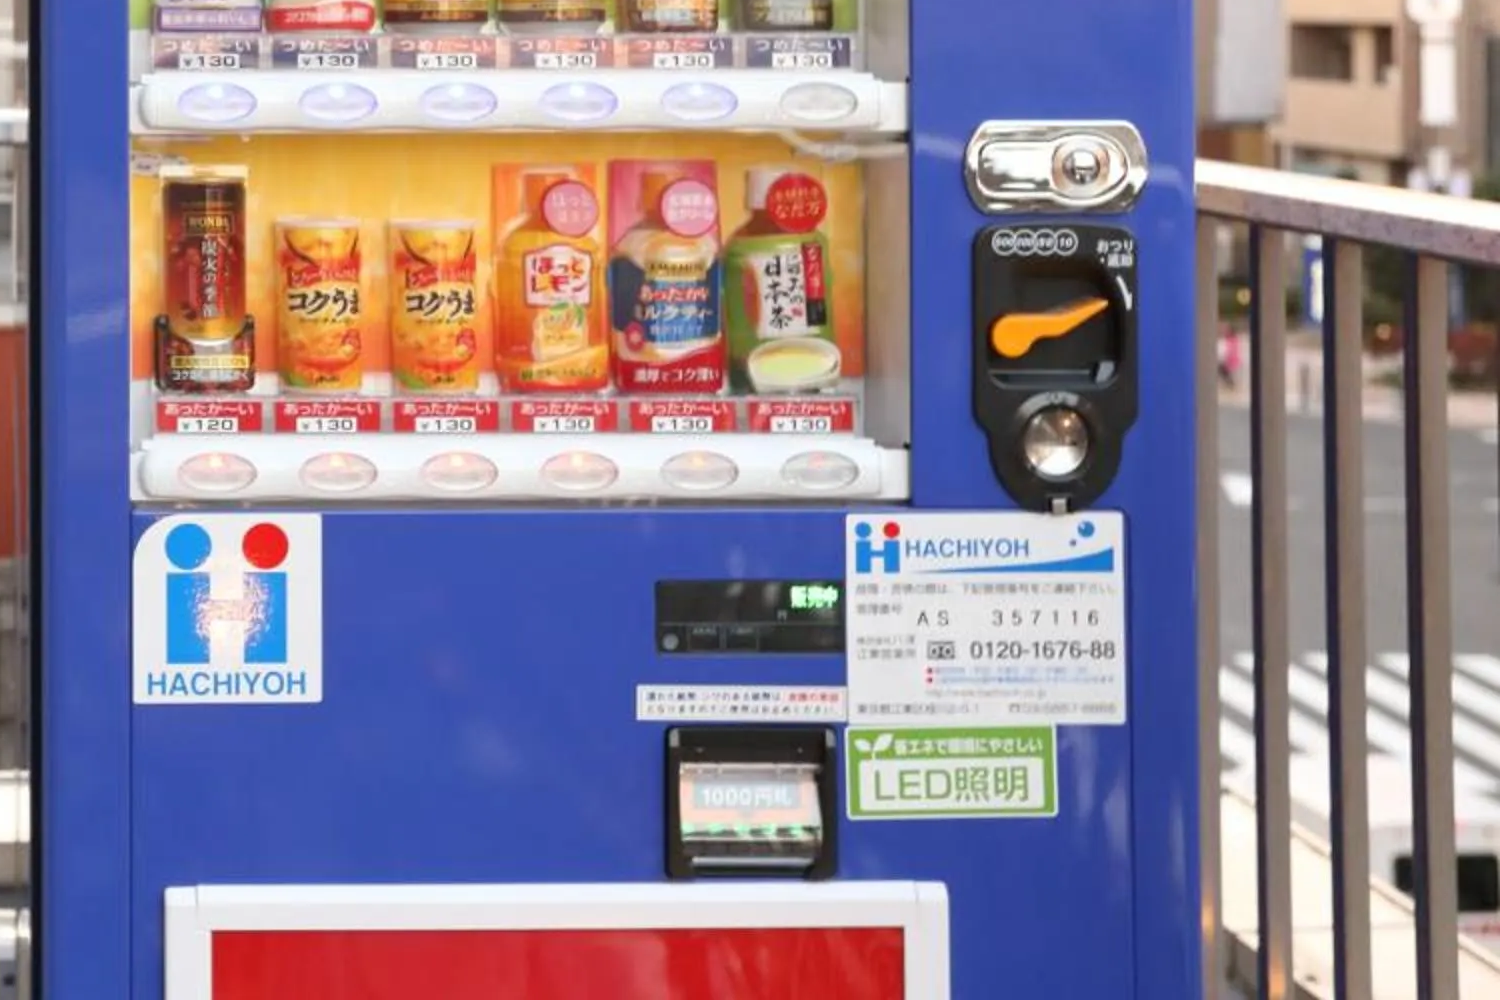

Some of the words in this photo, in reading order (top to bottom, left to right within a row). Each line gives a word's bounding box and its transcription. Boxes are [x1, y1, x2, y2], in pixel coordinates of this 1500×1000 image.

[182, 54, 236, 68] ¥130
[301, 54, 355, 67] ¥130
[420, 54, 473, 67] ¥130
[540, 54, 593, 67] ¥130
[658, 54, 711, 67] ¥130
[777, 54, 829, 67] ¥130
[182, 418, 234, 432] ¥120
[301, 418, 354, 432] ¥130
[420, 418, 473, 432] ¥130
[537, 417, 591, 431] ¥130
[656, 417, 709, 431] ¥130
[775, 417, 827, 431] ¥130
[905, 539, 1030, 558] HACHIYOH
[969, 640, 1116, 661] 0120-1676-88
[147, 671, 307, 696] HACHIYOH
[874, 764, 1030, 803] LED照明
